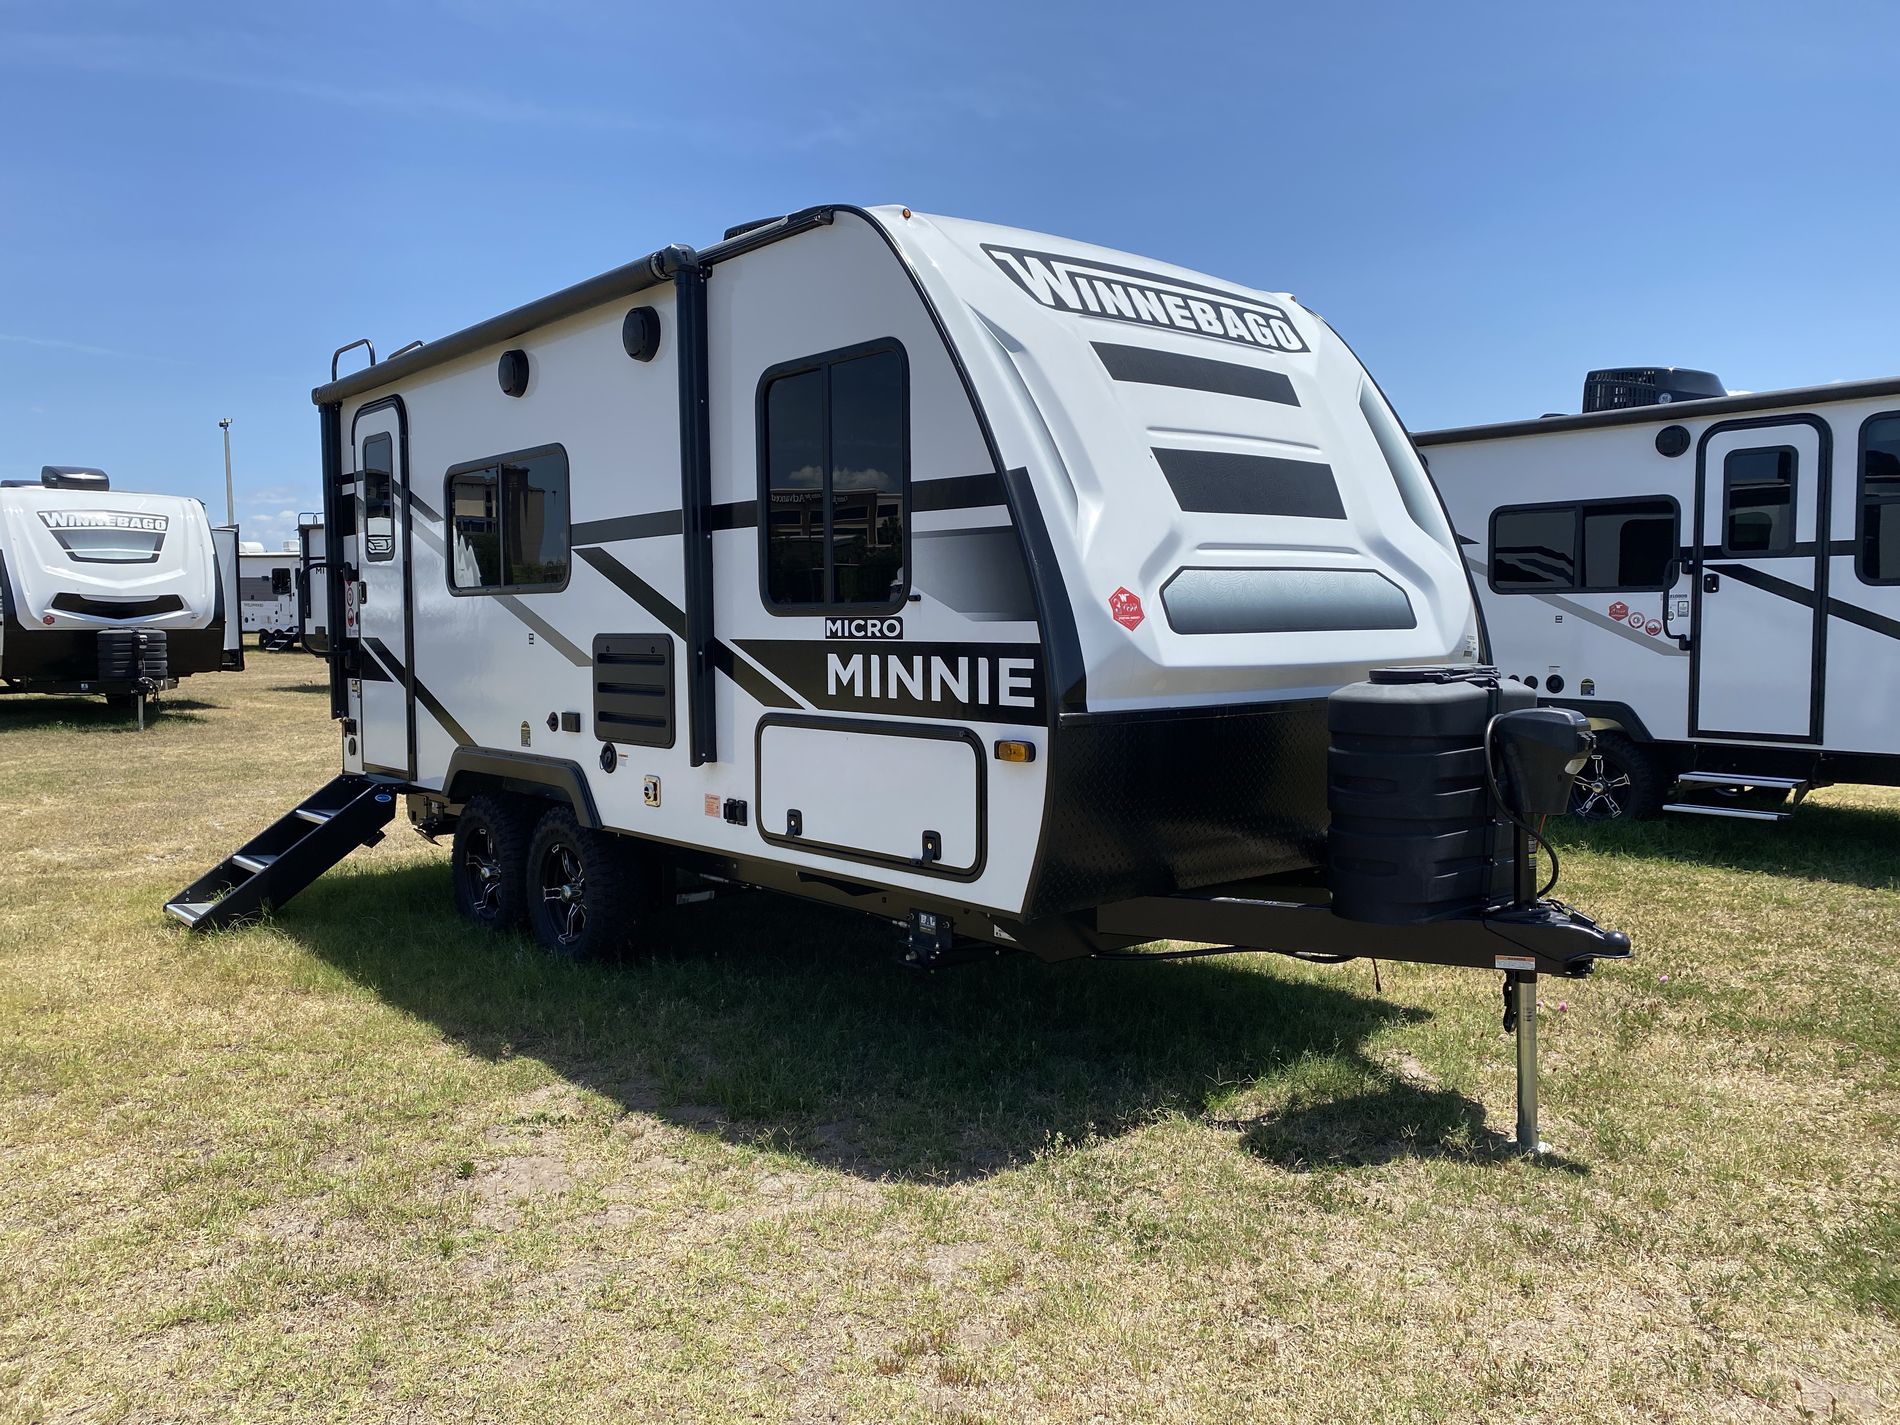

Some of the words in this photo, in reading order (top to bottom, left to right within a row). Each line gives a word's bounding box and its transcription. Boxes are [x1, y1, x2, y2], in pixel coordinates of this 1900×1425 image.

[988, 249, 1303, 352] WINNEBAGO
[39, 511, 167, 531] WINNEBAGO
[826, 619, 901, 638] MICRO
[827, 653, 1035, 708] MINNIE
